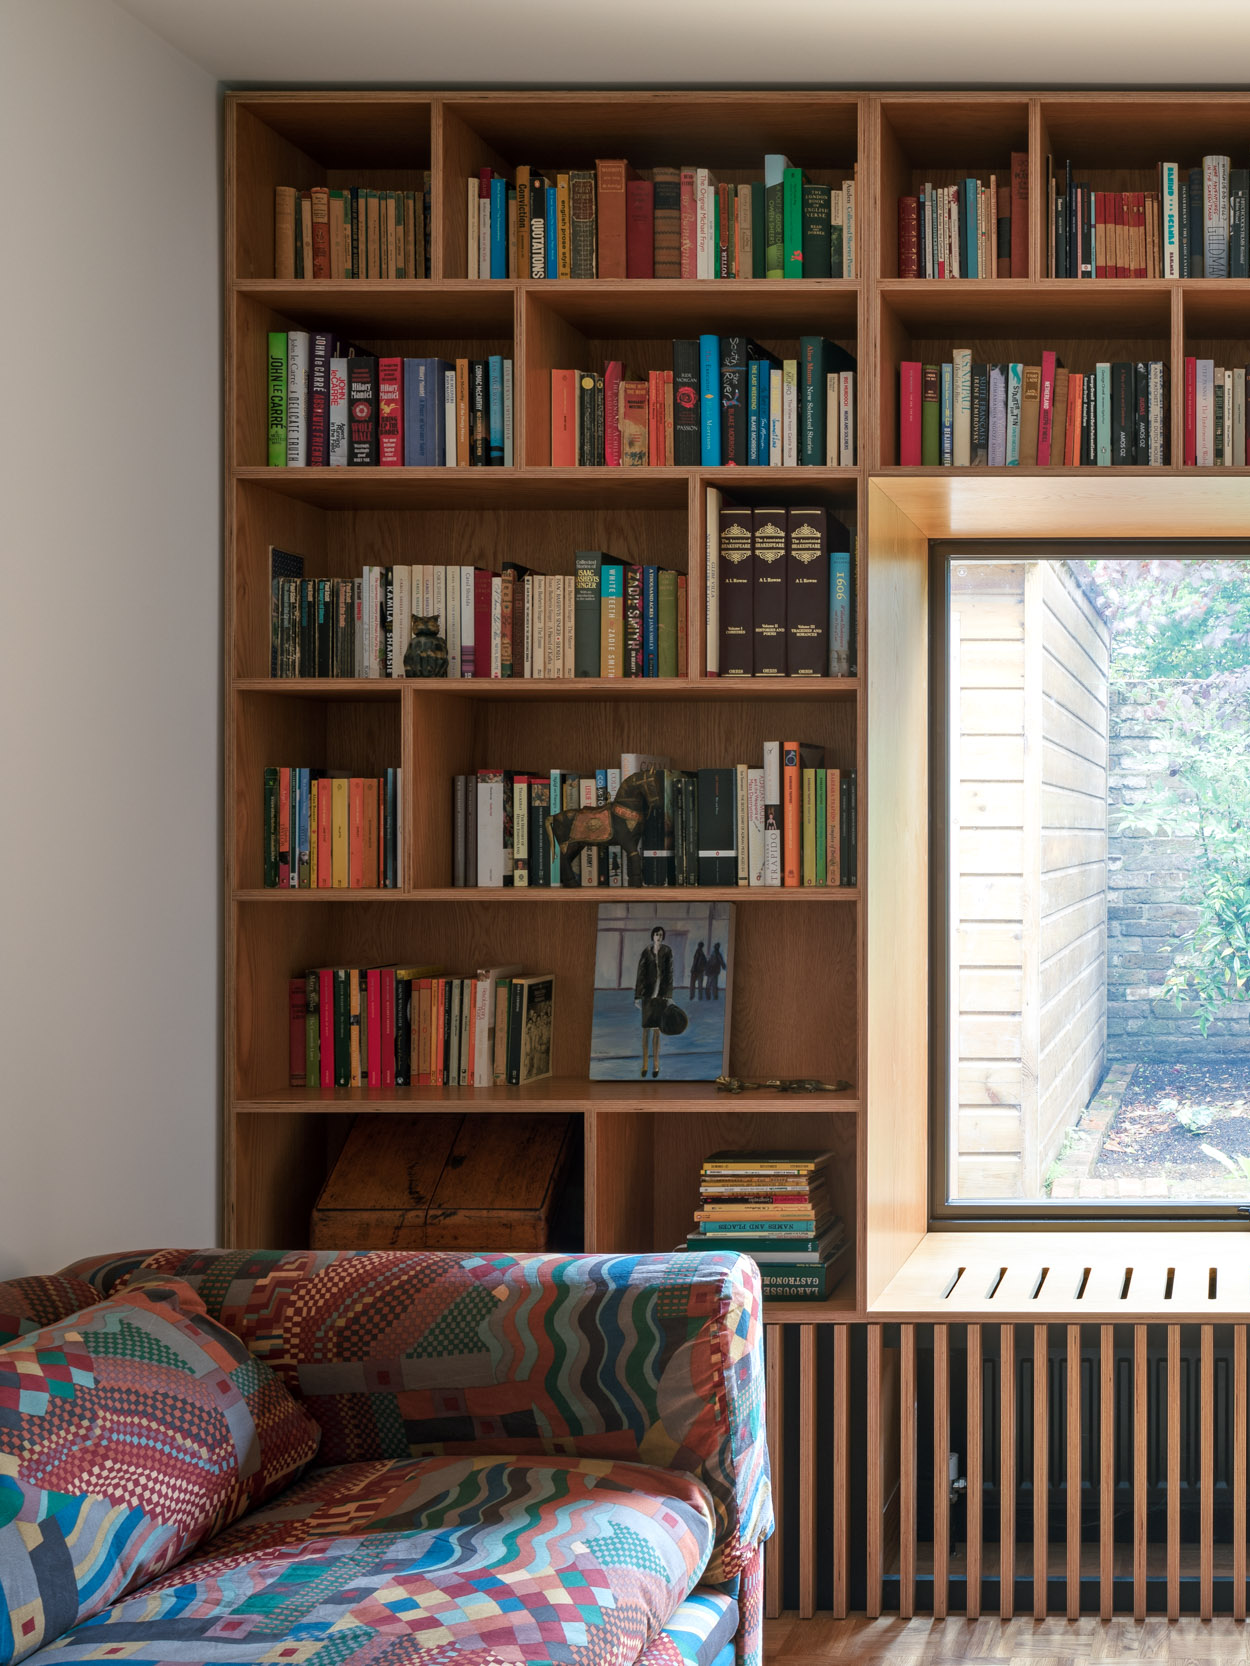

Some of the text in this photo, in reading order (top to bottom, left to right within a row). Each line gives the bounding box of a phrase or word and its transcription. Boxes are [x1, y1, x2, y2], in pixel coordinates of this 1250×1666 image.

[518, 184, 527, 228] Conviction
[698, 189, 706, 211] Original
[531, 218, 545, 279] QUOTATIONS
[698, 236, 706, 252] Frayn
[1207, 226, 1225, 278] GOLDMAN
[289, 338, 297, 353] John
[315, 336, 326, 355] JOHN
[730, 338, 739, 366] South
[290, 363, 298, 385] Carré
[314, 367, 326, 391] CARRÉ
[724, 373, 732, 399] River
[270, 355, 287, 429] JOHN LE CARRÉ
[331, 370, 339, 406] leCARRÉ
[338, 377, 346, 400] JOHN
[289, 397, 299, 433] DELICATE
[312, 394, 325, 429] ABSOLUTE
[289, 437, 299, 462] TRUTH
[311, 433, 324, 466] FRIENDS
[1140, 439, 1145, 447] OZ
[836, 572, 846, 600] 1606
[627, 572, 639, 649] ZADIE SMITH
[763, 1287, 820, 1295] LAROUSSE
